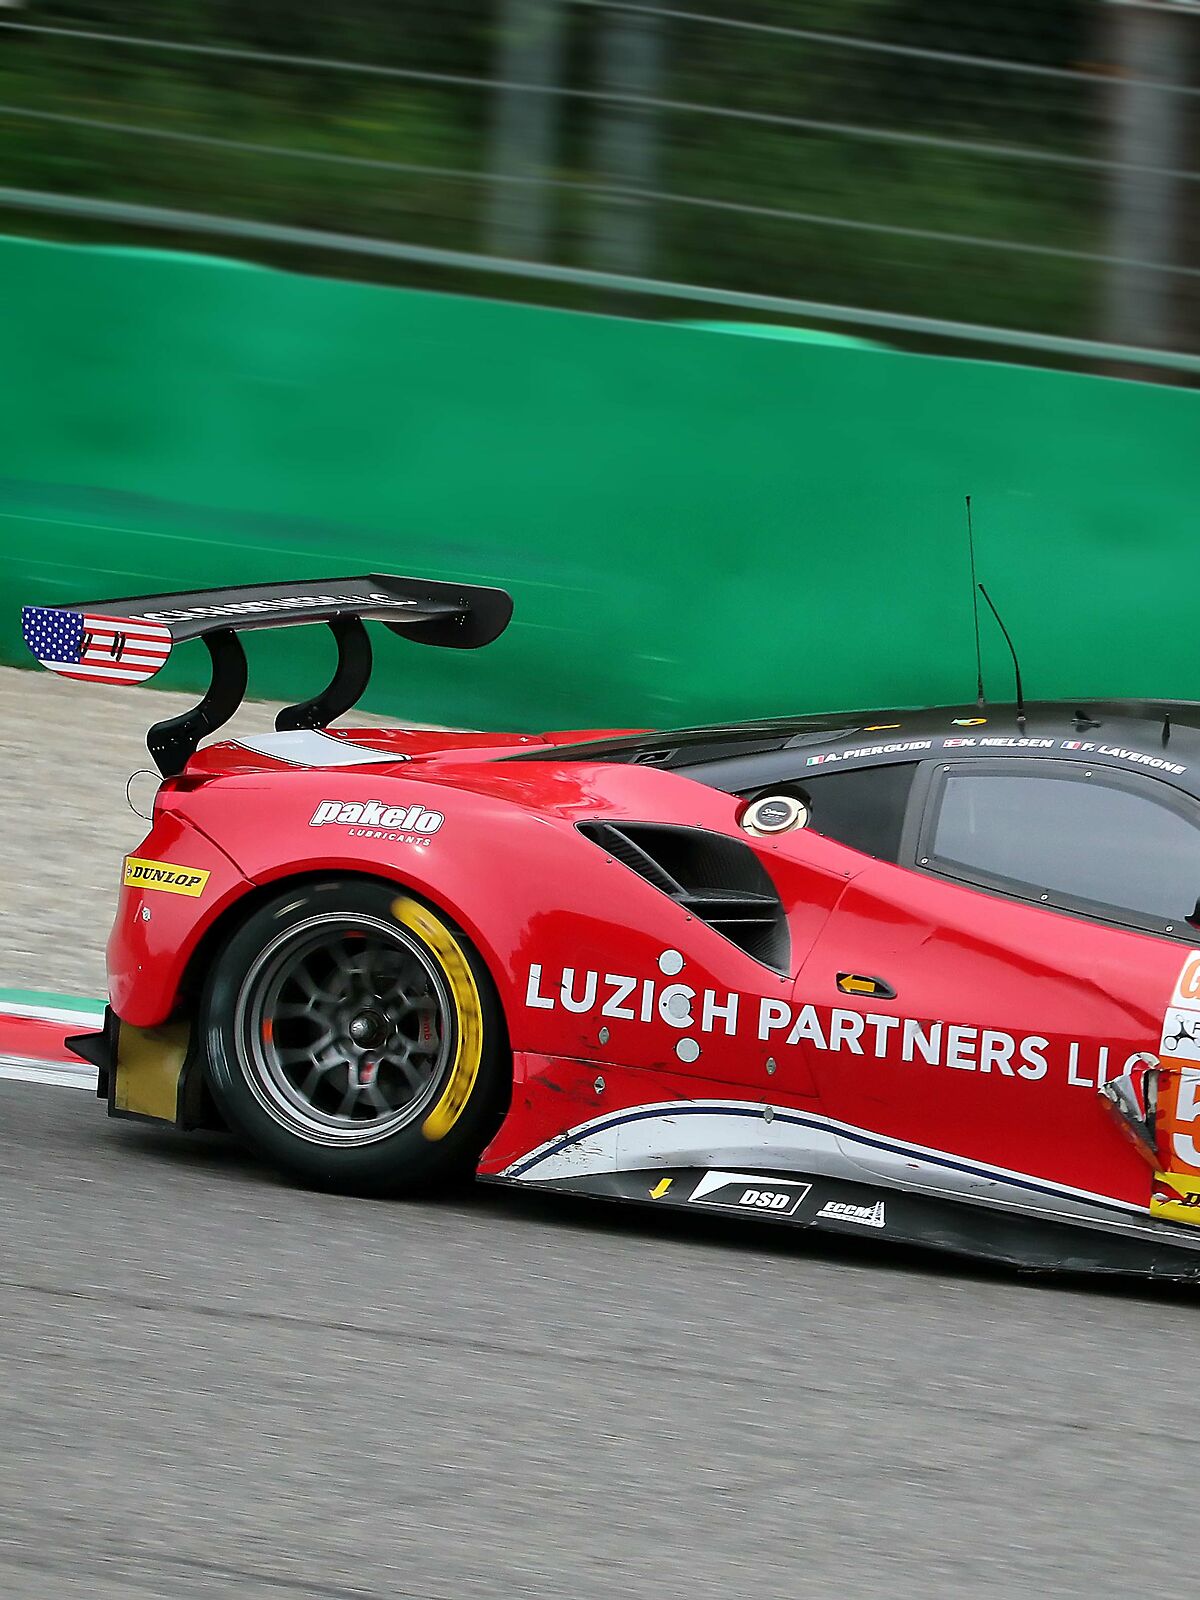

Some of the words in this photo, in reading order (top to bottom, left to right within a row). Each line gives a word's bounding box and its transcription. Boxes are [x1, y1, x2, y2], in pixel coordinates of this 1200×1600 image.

[979, 737, 1055, 748] NIELSEN
[309, 799, 445, 835] pakelo
[348, 828, 431, 846] LUBRICANTS
[132, 866, 202, 887] DUNLOP
[525, 963, 739, 1036] LUZICH
[758, 998, 1050, 1081] PARTNERS
[738, 1189, 791, 1209] DSD
[822, 1201, 871, 1219] ECCM
